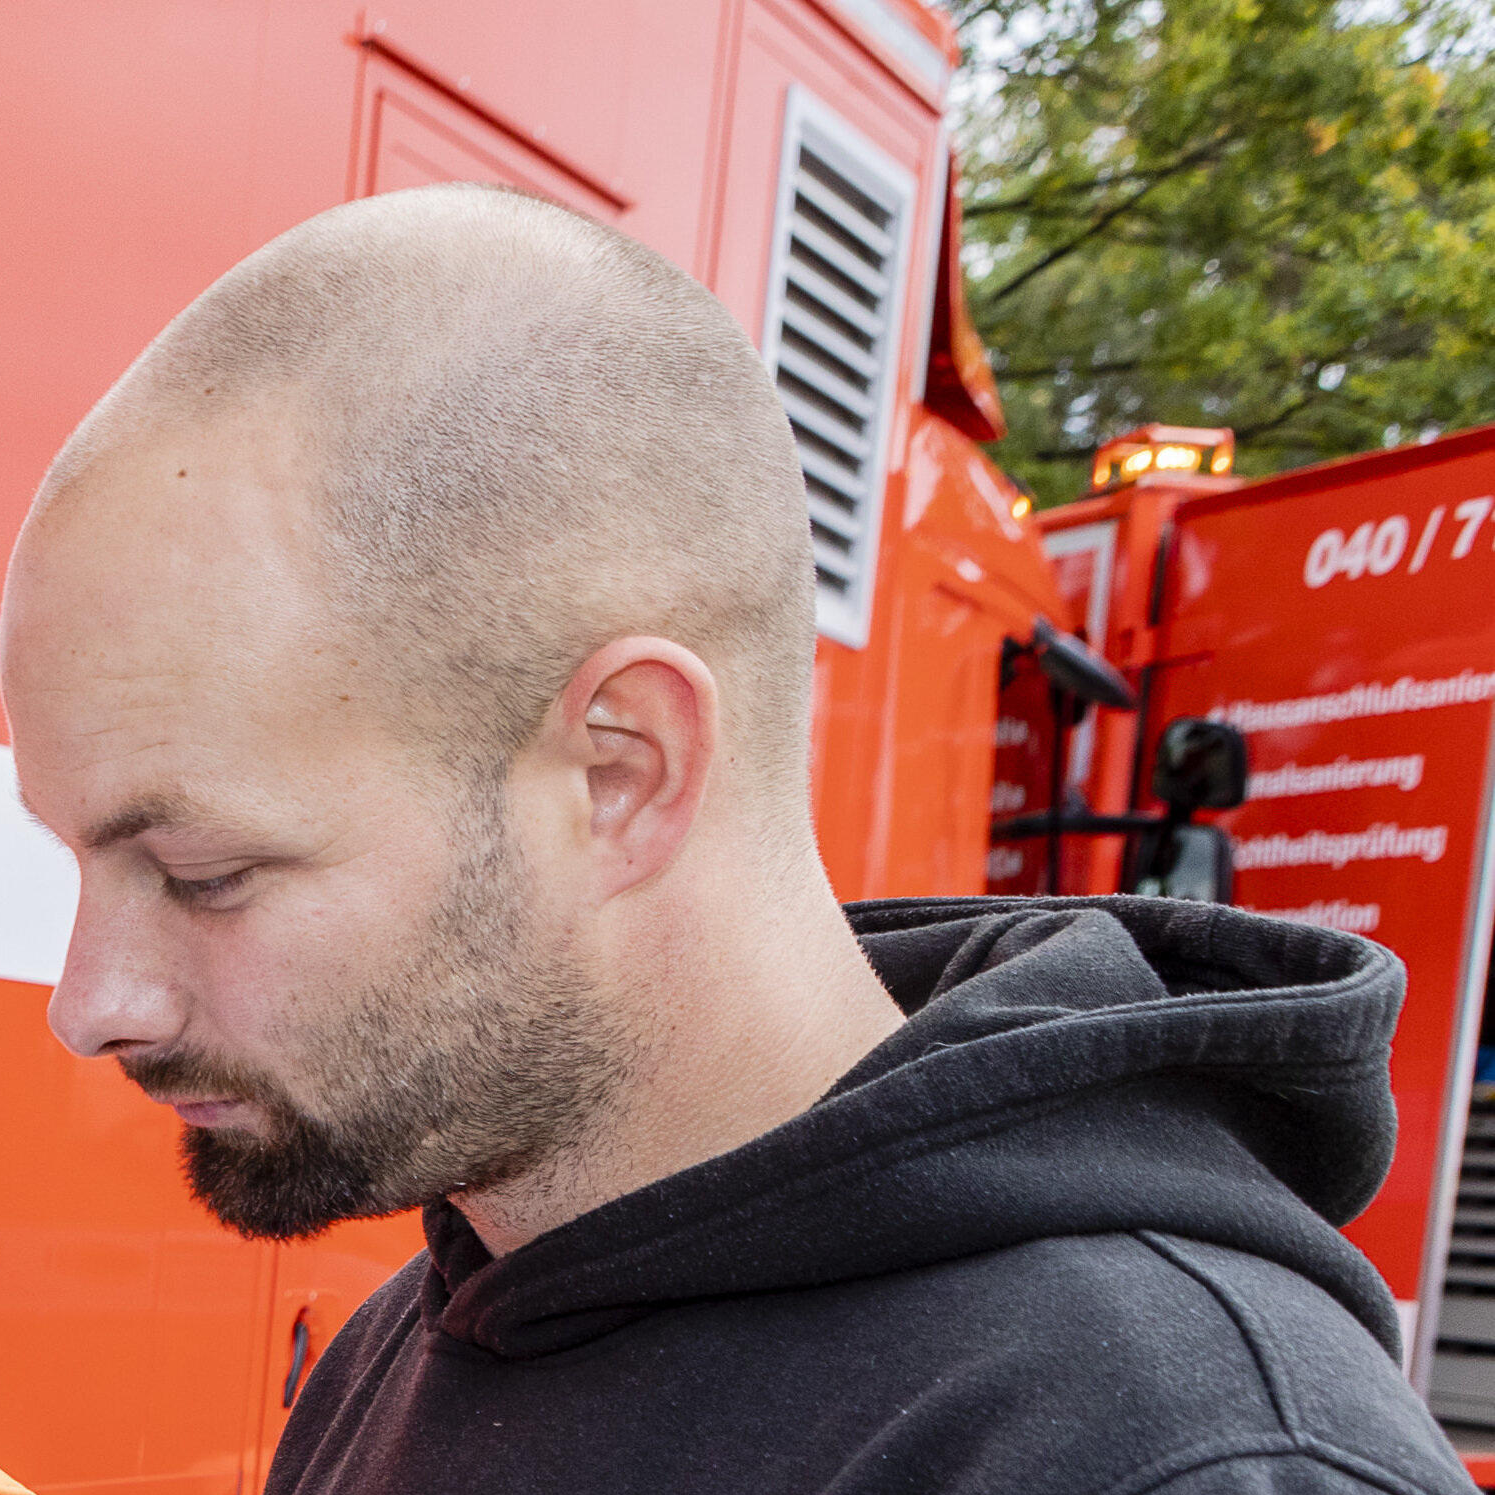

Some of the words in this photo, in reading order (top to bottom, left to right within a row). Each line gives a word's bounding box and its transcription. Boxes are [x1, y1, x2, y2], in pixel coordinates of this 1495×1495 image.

[1303, 514, 1410, 589] 040
[1407, 504, 1448, 575] /
[1451, 494, 1495, 561] 7
